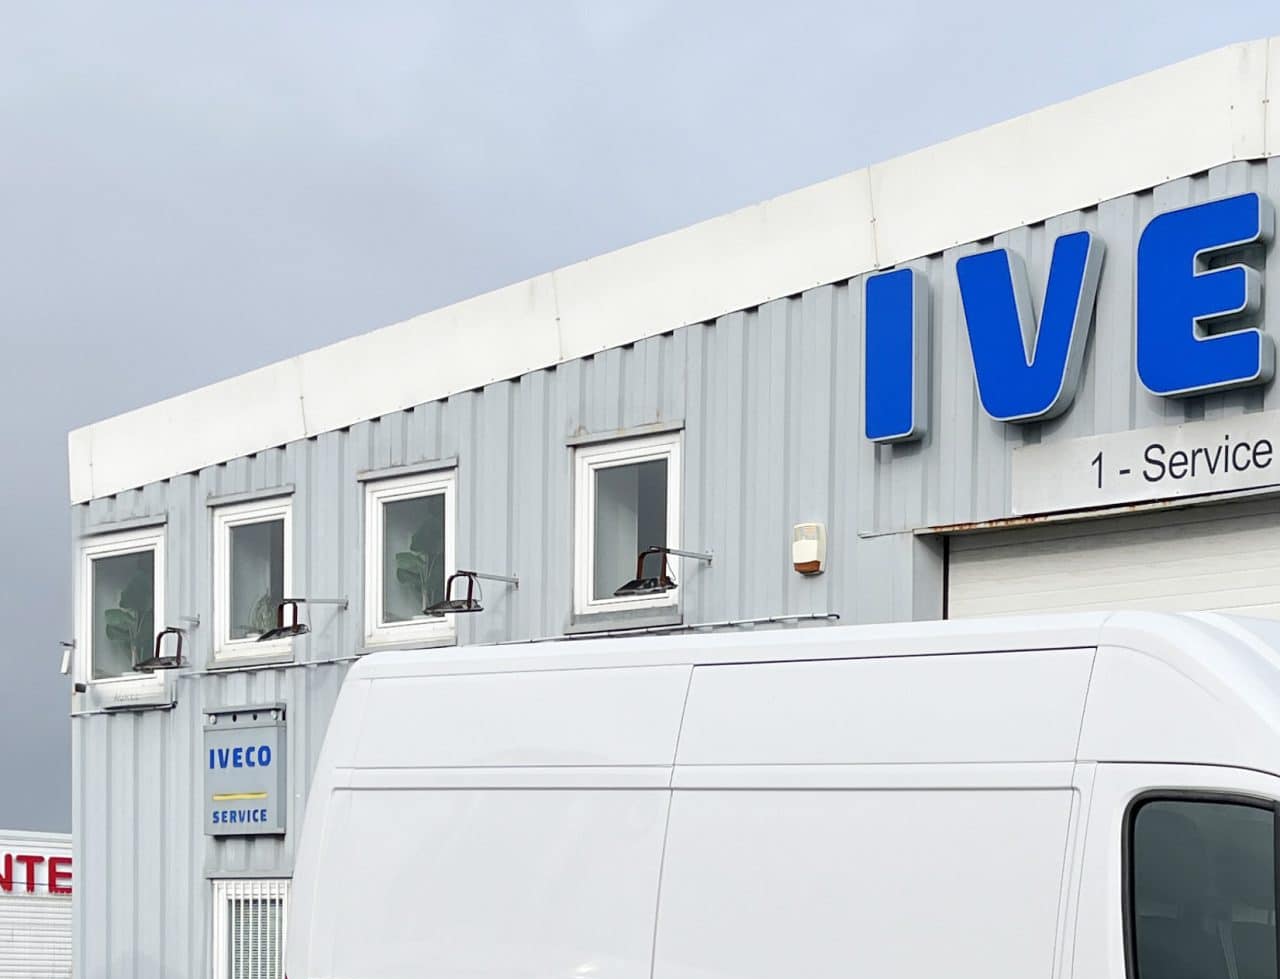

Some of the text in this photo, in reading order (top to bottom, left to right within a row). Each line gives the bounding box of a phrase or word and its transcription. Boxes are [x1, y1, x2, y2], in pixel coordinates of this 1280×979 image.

[1091, 451, 1103, 489] 1
[1142, 434, 1273, 482] Service
[209, 745, 272, 769] IVECO
[212, 808, 268, 824] SERVICE
